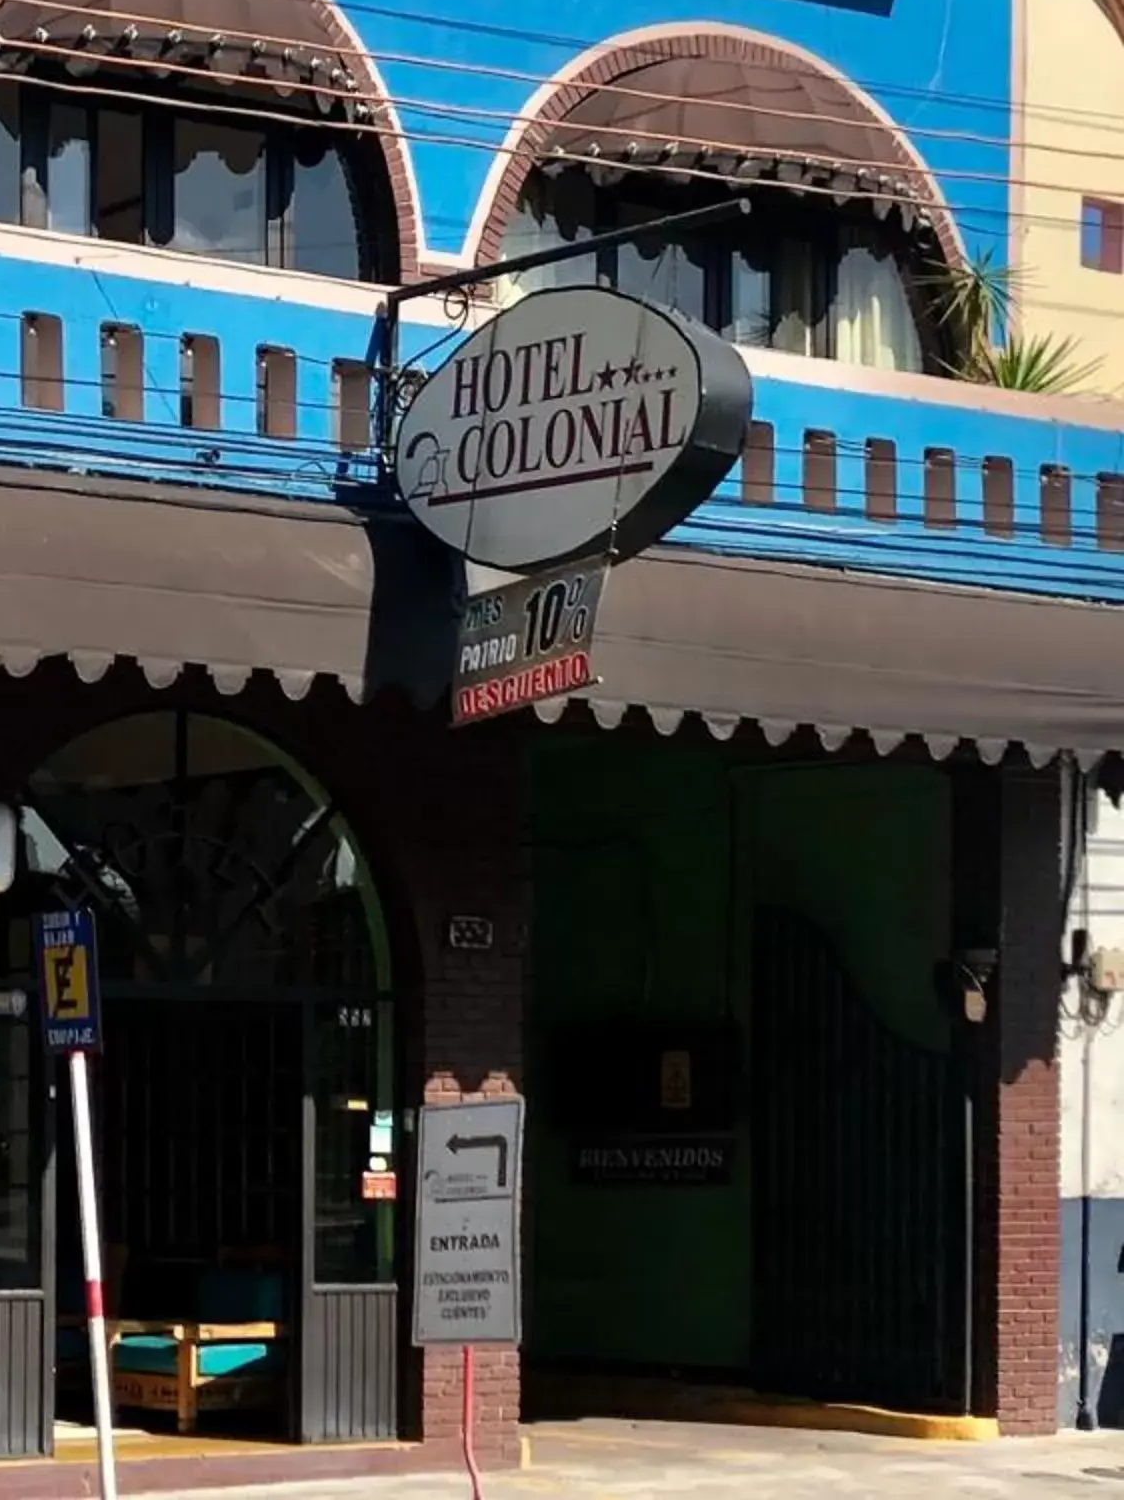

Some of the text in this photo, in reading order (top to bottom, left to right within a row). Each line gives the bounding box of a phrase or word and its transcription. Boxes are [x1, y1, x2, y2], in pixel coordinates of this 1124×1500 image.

[450, 333, 596, 419] HOTEL
[457, 388, 687, 484] COLONIAL
[459, 633, 517, 674] PATRIO
[523, 574, 590, 660] 10%
[429, 1232, 501, 1252] ENTRADA
